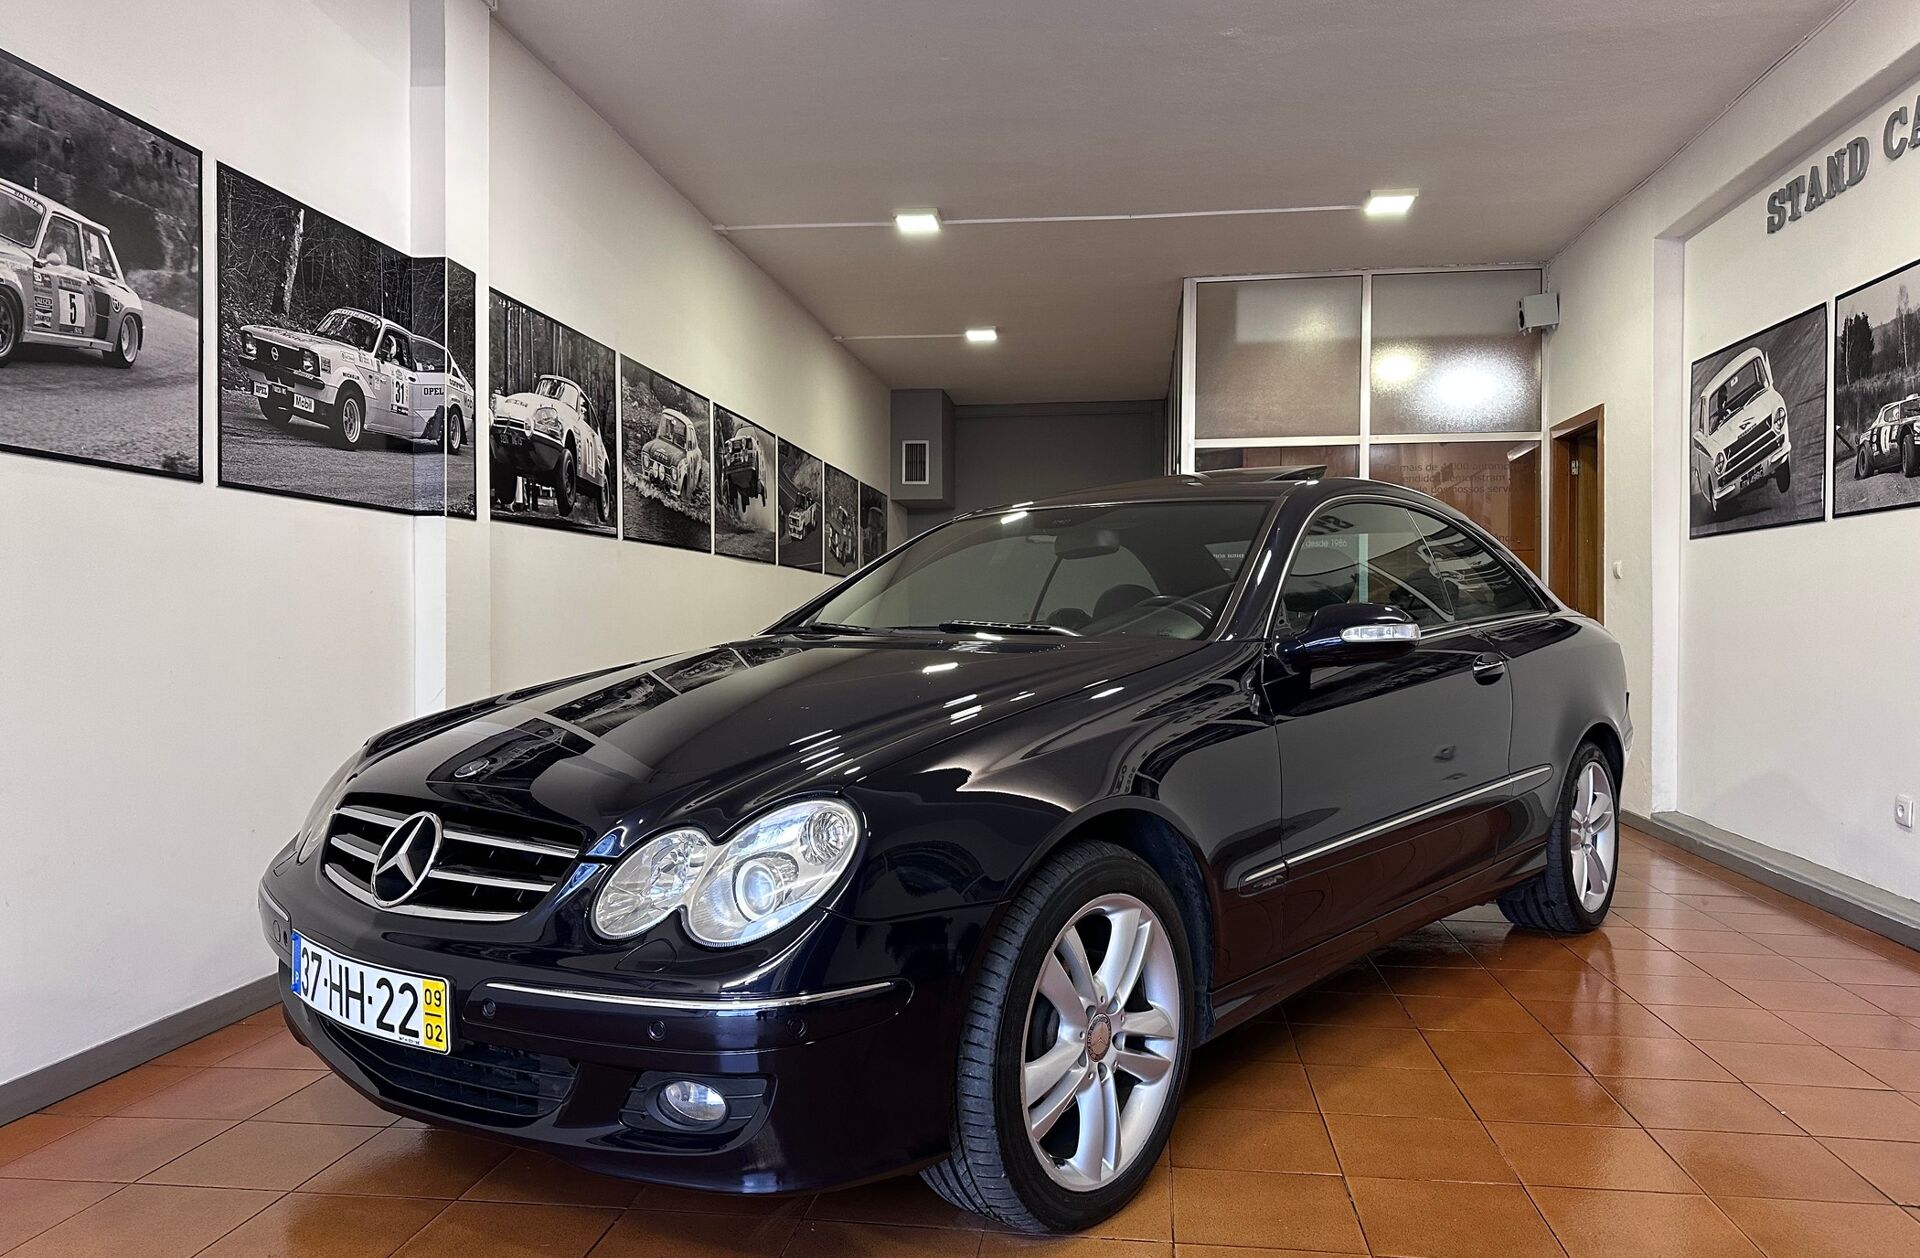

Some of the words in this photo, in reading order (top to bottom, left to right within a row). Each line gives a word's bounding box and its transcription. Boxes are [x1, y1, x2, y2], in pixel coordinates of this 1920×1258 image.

[1767, 137, 1870, 234] STAND
[69, 294, 77, 324] 5
[255, 385, 267, 395] OPEL
[395, 381, 405, 404] 31
[423, 387, 444, 395] OPEL
[295, 396, 313, 409] Mobil
[1426, 463, 1438, 471] de
[1331, 538, 1348, 547] 1986
[425, 989, 442, 1008] 09
[425, 1023, 443, 1042] 02
